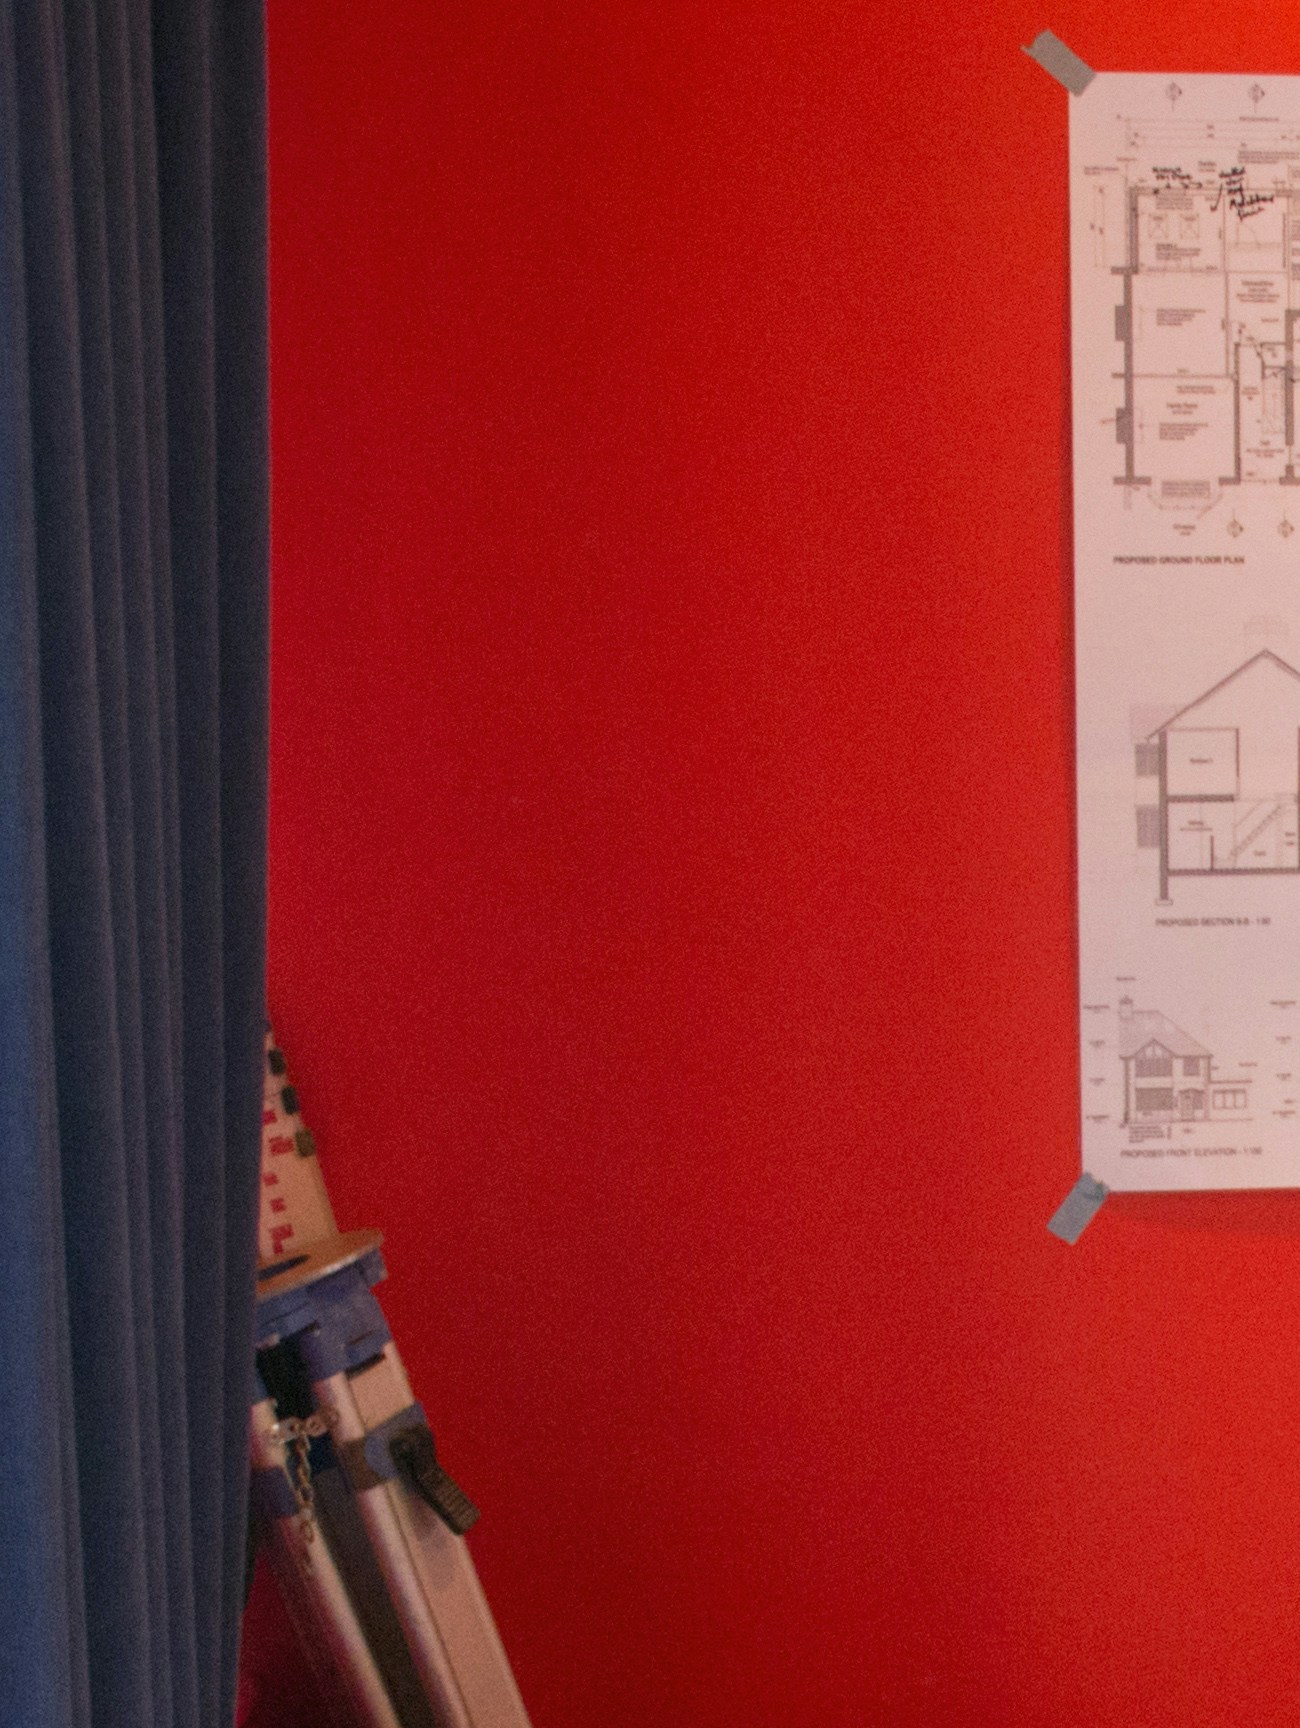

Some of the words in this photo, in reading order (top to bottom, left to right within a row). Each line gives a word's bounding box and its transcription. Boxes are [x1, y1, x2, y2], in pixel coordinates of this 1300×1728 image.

[1113, 556, 1157, 565] PROPOSED
[1159, 556, 1192, 565] GROUND
[1195, 556, 1222, 565] FLOOR
[1224, 556, 1245, 565] PLAN
[1156, 918, 1199, 926] PROPOSED
[1201, 918, 1235, 926] SECTION
[1120, 1149, 1164, 1158] PROPOSED
[1166, 1148, 1191, 1158] FRONT
[1194, 1147, 1237, 1157] ELEVATION
